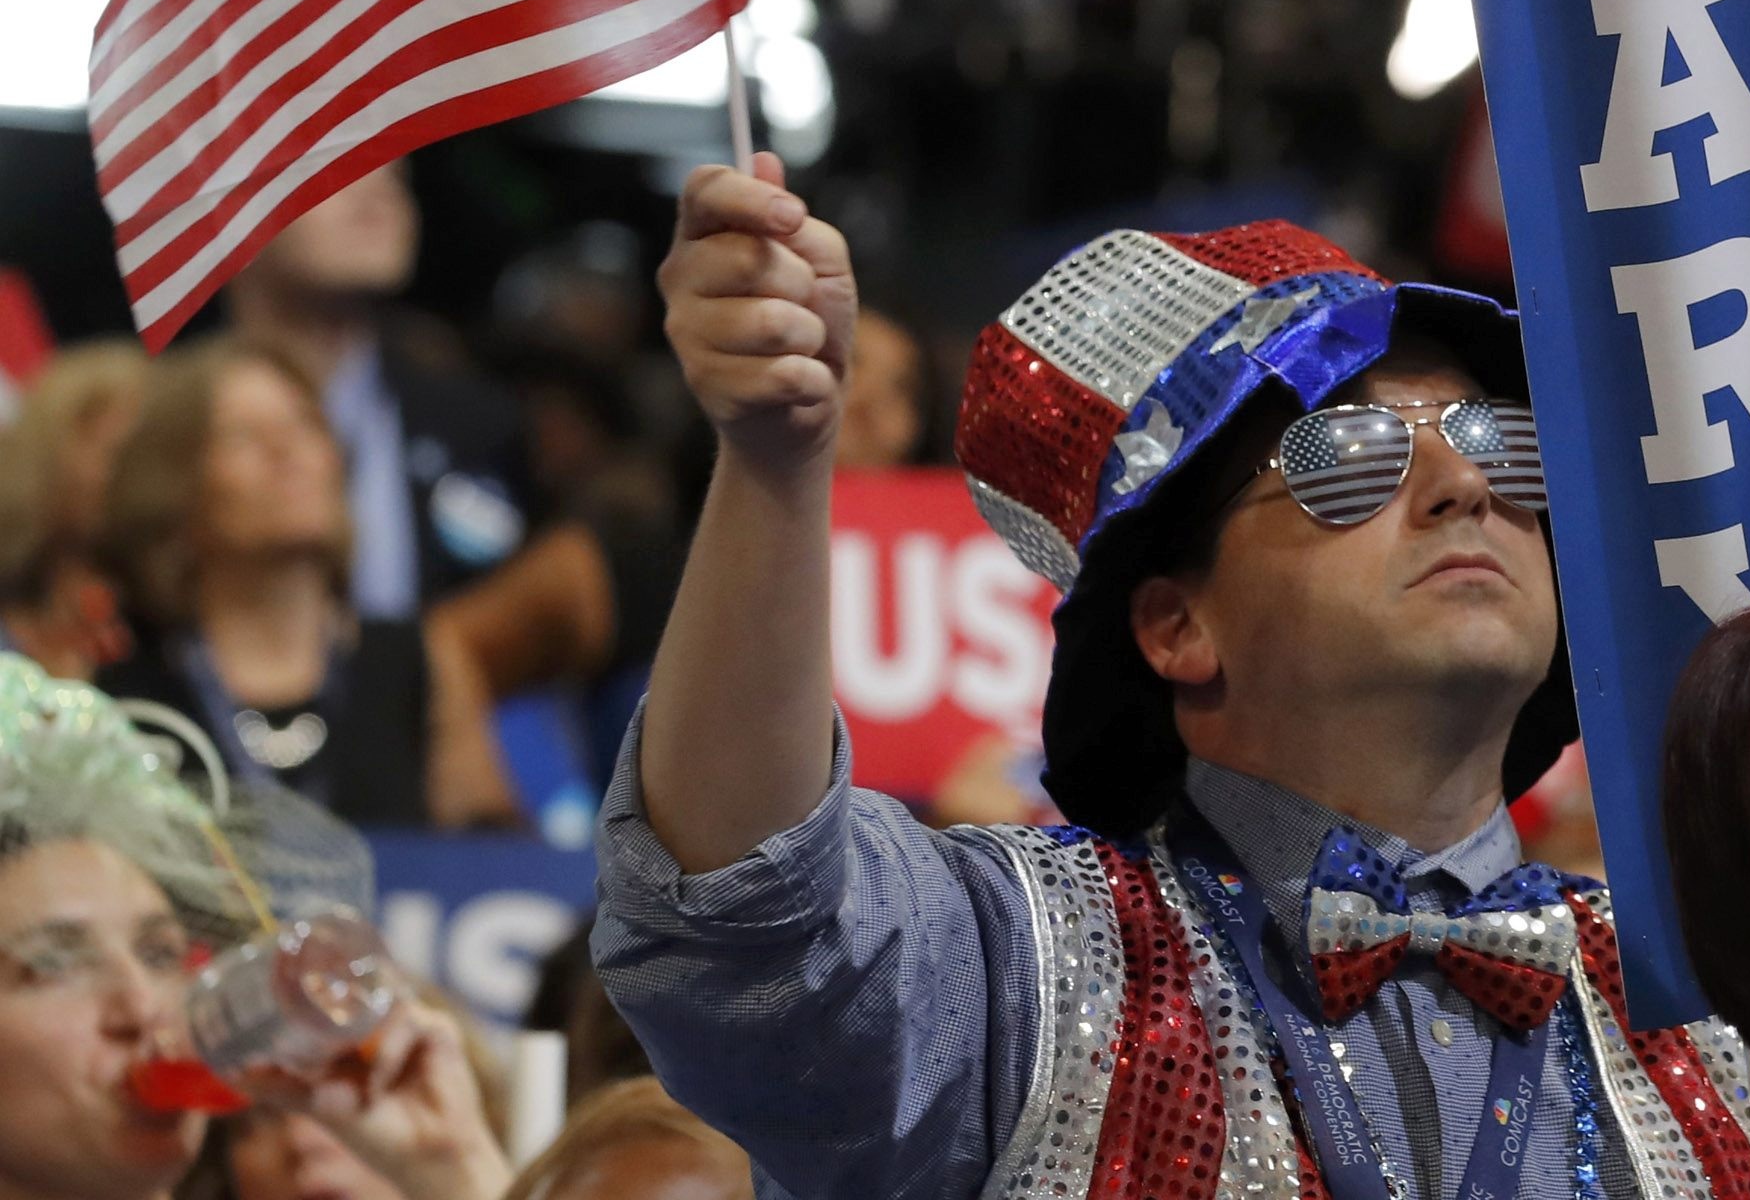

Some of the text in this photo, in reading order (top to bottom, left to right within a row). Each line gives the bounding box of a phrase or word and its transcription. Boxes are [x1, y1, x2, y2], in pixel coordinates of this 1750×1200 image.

[1183, 858, 1245, 925] COMCAST
[1284, 1013, 1351, 1167] NATIONAL CONVENTION
[1318, 1062, 1367, 1165] DEMOCRATIC
[1500, 1074, 1534, 1167] COMCAST
